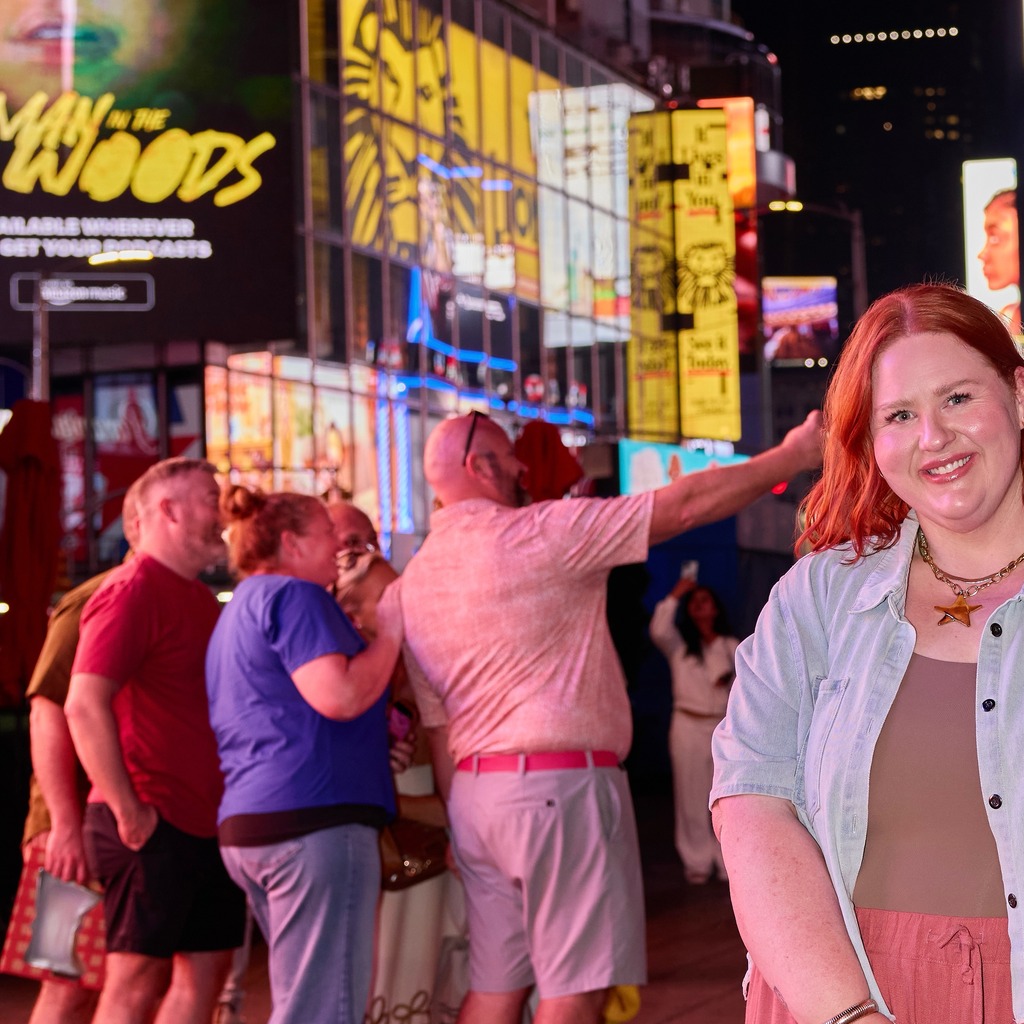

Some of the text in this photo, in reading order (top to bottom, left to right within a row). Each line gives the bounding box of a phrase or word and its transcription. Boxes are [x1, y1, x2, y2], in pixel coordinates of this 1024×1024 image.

[131, 107, 171, 132] THE
[2, 127, 276, 207] WOODS
[80, 217, 195, 237] WHEREVER
[0, 238, 212, 259] GET YOUR PODCASTS
